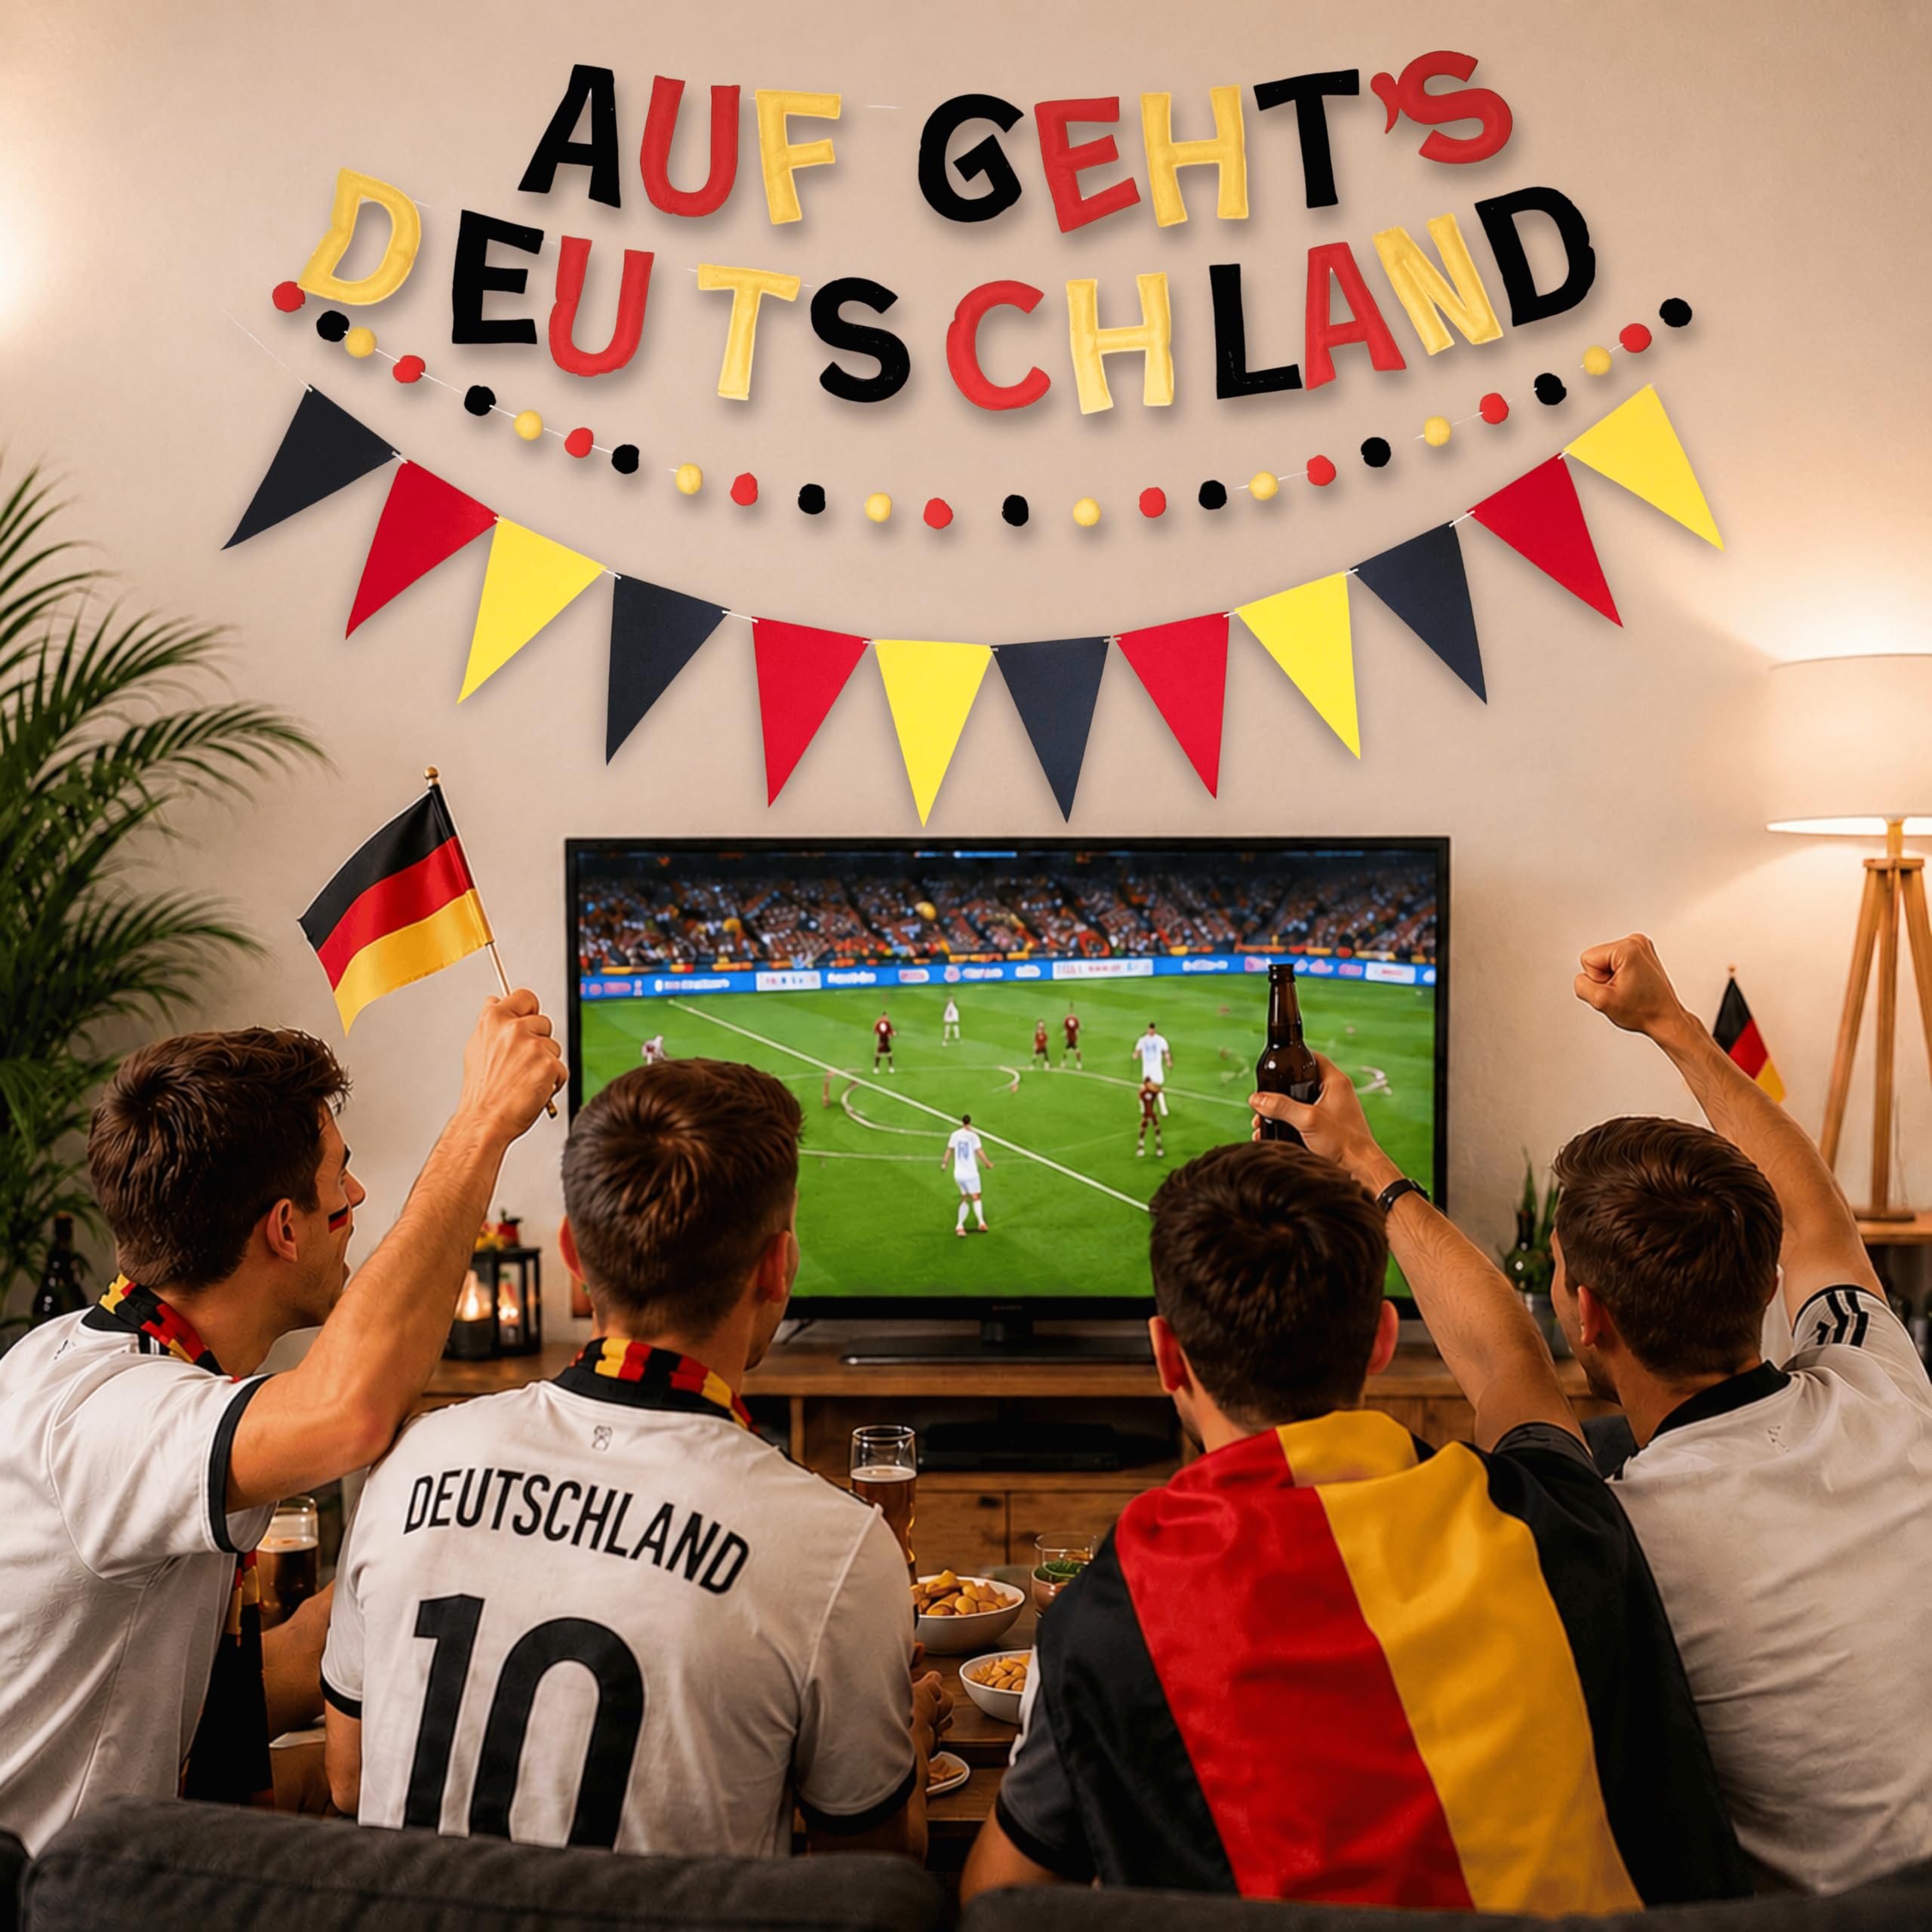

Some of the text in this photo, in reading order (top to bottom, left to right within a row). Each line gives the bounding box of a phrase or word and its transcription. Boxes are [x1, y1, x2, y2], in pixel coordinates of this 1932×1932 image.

[517, 50, 1513, 233] AUF GEHT'S
[297, 168, 1596, 414] DEUTSCHLAND
[403, 1467, 749, 1595] DEUTSCHLAND
[403, 1593, 646, 1851] 10
